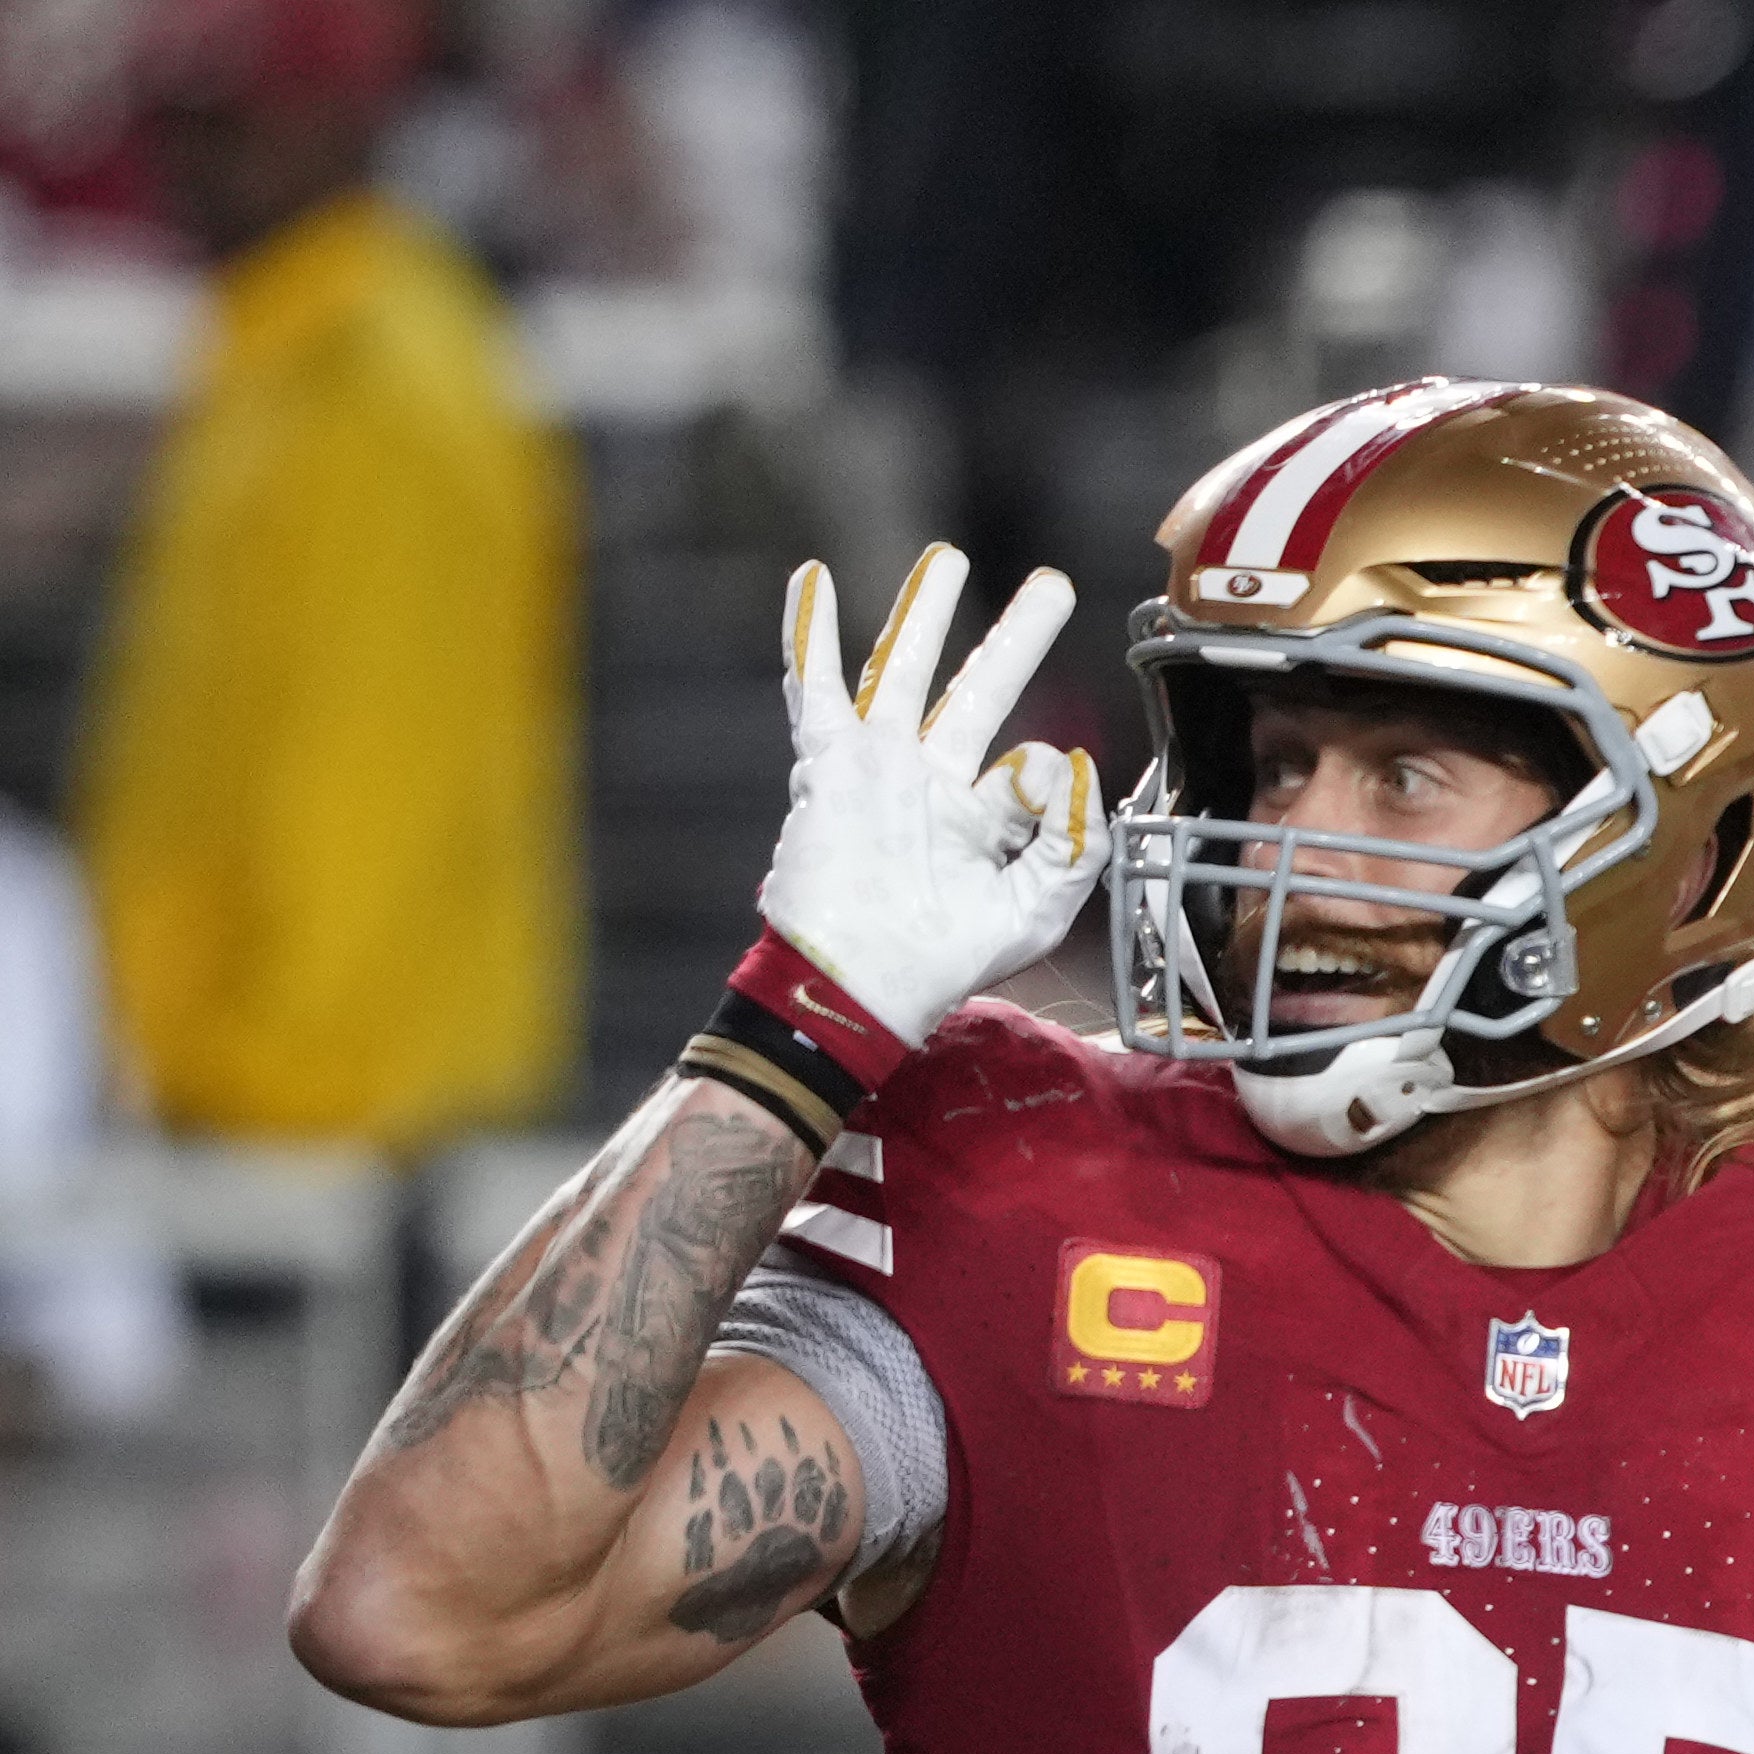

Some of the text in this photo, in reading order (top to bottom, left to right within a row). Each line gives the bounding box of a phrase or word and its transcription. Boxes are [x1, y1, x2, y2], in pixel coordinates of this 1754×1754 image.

[1067, 1253, 1207, 1366] C
[1500, 1359, 1552, 1397] NFL
[1420, 1501, 1614, 1579] 49ERS
